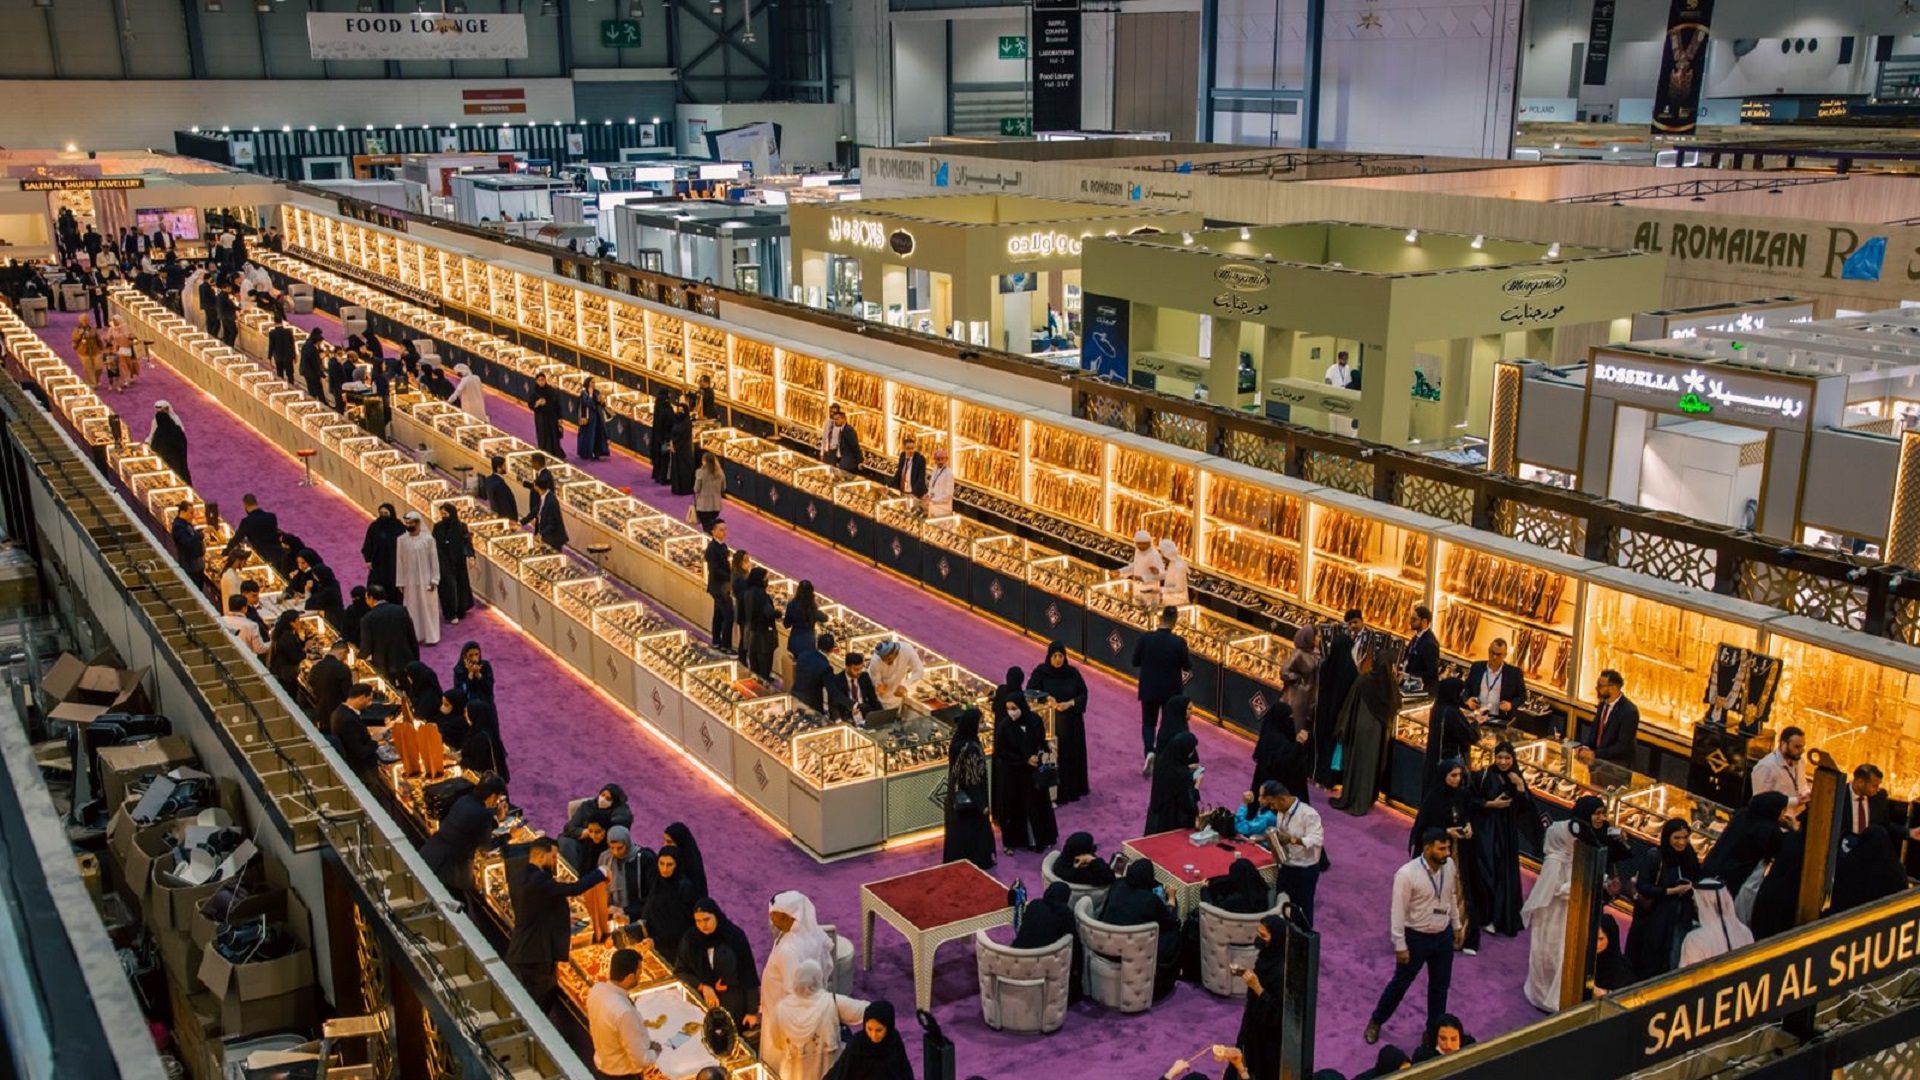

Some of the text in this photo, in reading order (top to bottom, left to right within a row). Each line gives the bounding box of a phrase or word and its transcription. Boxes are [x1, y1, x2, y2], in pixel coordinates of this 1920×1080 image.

[345, 18, 489, 34] FOOD LONGE
[1528, 105, 1555, 114] POLAND
[867, 156, 878, 176] AL
[879, 157, 925, 182] ROMAIZAN
[1634, 220, 1664, 253] AL
[1670, 222, 1808, 269] ROMAIZAN
[1500, 302, 1565, 326] مورجنايت
[1594, 363, 1680, 392] ROSSELLA
[1707, 378, 1803, 418] روسيلا
[1644, 973, 1771, 1056] SALEM
[1776, 956, 1818, 1007] AL
